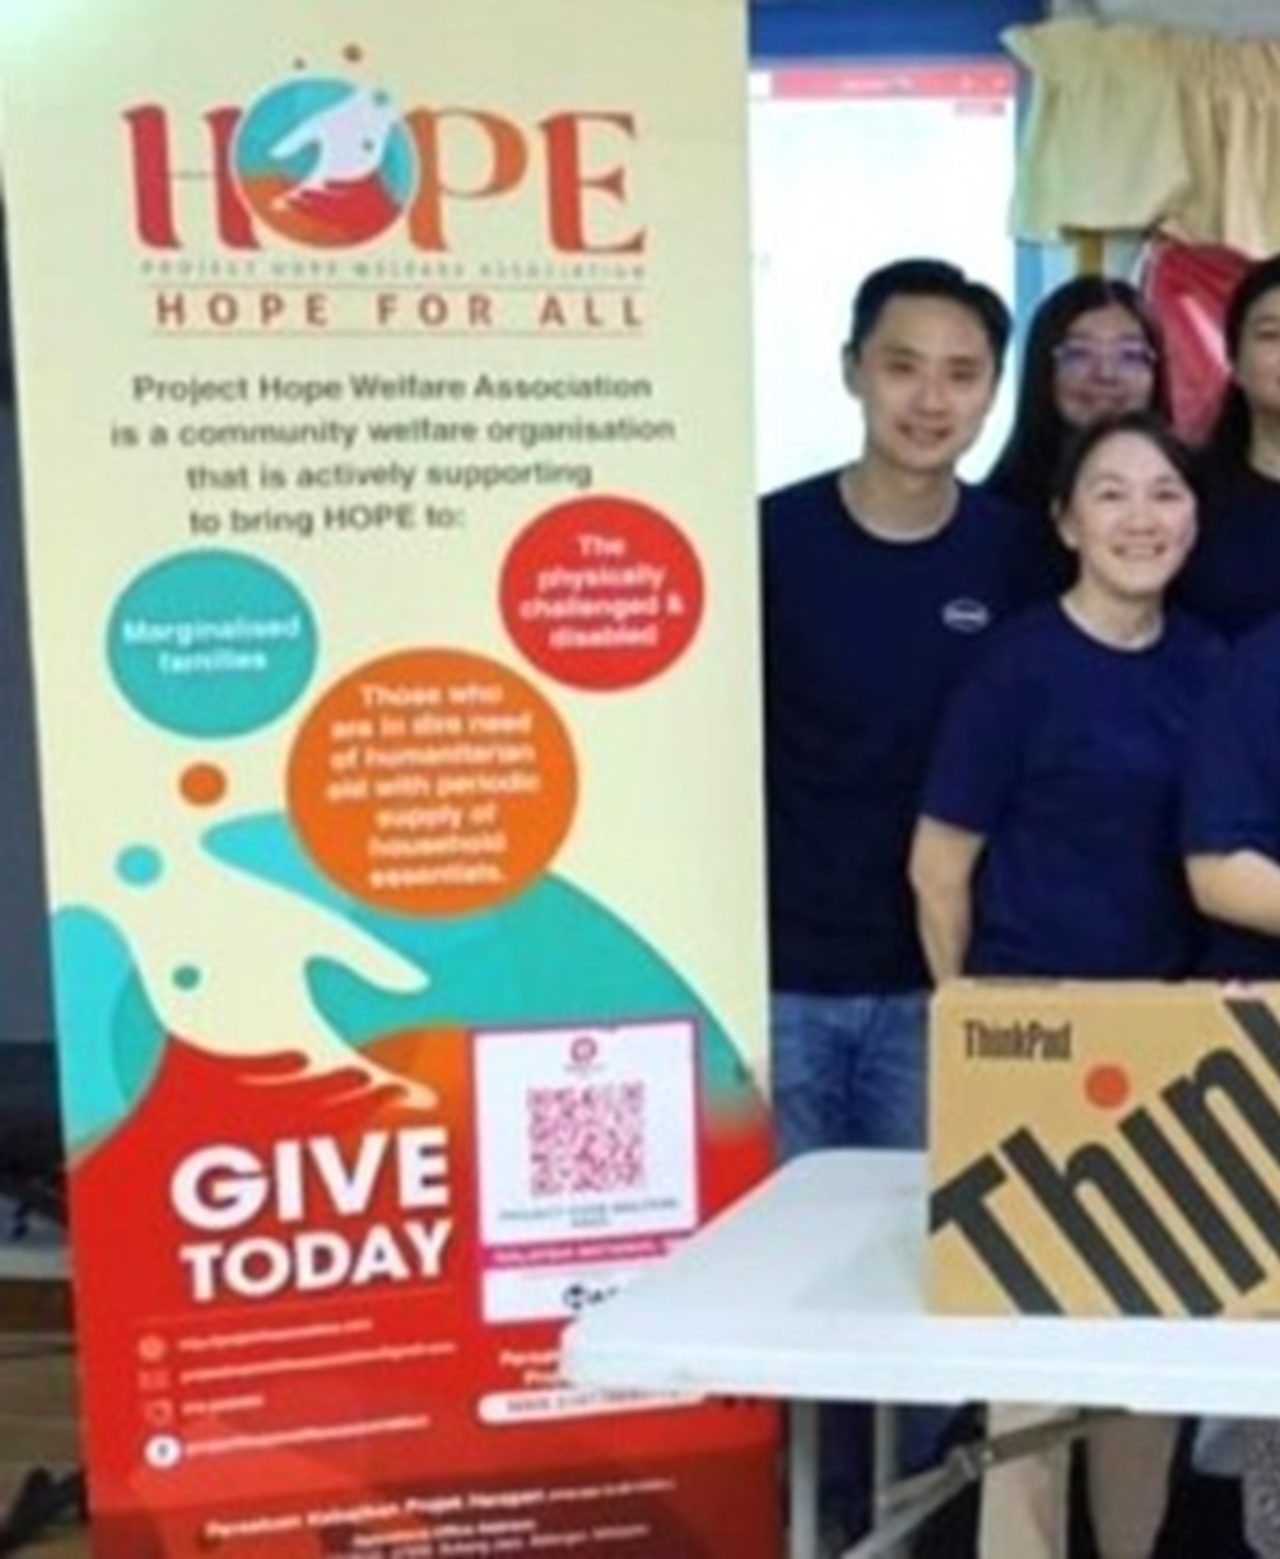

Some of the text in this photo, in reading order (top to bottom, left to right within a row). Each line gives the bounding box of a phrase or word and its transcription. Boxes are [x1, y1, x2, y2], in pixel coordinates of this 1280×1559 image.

[121, 77, 646, 254] HOPE
[156, 293, 643, 326] HOPE FOR ALL
[133, 374, 652, 405] Project Hope Welfare Association
[111, 418, 675, 449] is a community welfare organisation
[187, 461, 592, 492] that is actively supporting
[189, 506, 466, 537] to bring HOPE to:
[577, 535, 625, 556] The
[538, 564, 666, 591] physically
[519, 592, 659, 622] challenged
[123, 615, 299, 647] Marginalised
[550, 624, 658, 649] disabled
[158, 649, 267, 675] families
[361, 683, 504, 707] Those who
[331, 719, 372, 741] are
[381, 716, 407, 738] in
[469, 712, 532, 734] need
[331, 742, 535, 771] of humanitarian
[376, 774, 431, 798] with
[437, 772, 539, 799] periodic
[378, 802, 497, 831] supply of
[963, 1019, 1071, 1061] ThinkPad
[171, 1126, 449, 1230] GIVE
[179, 1220, 453, 1301] TODAY
